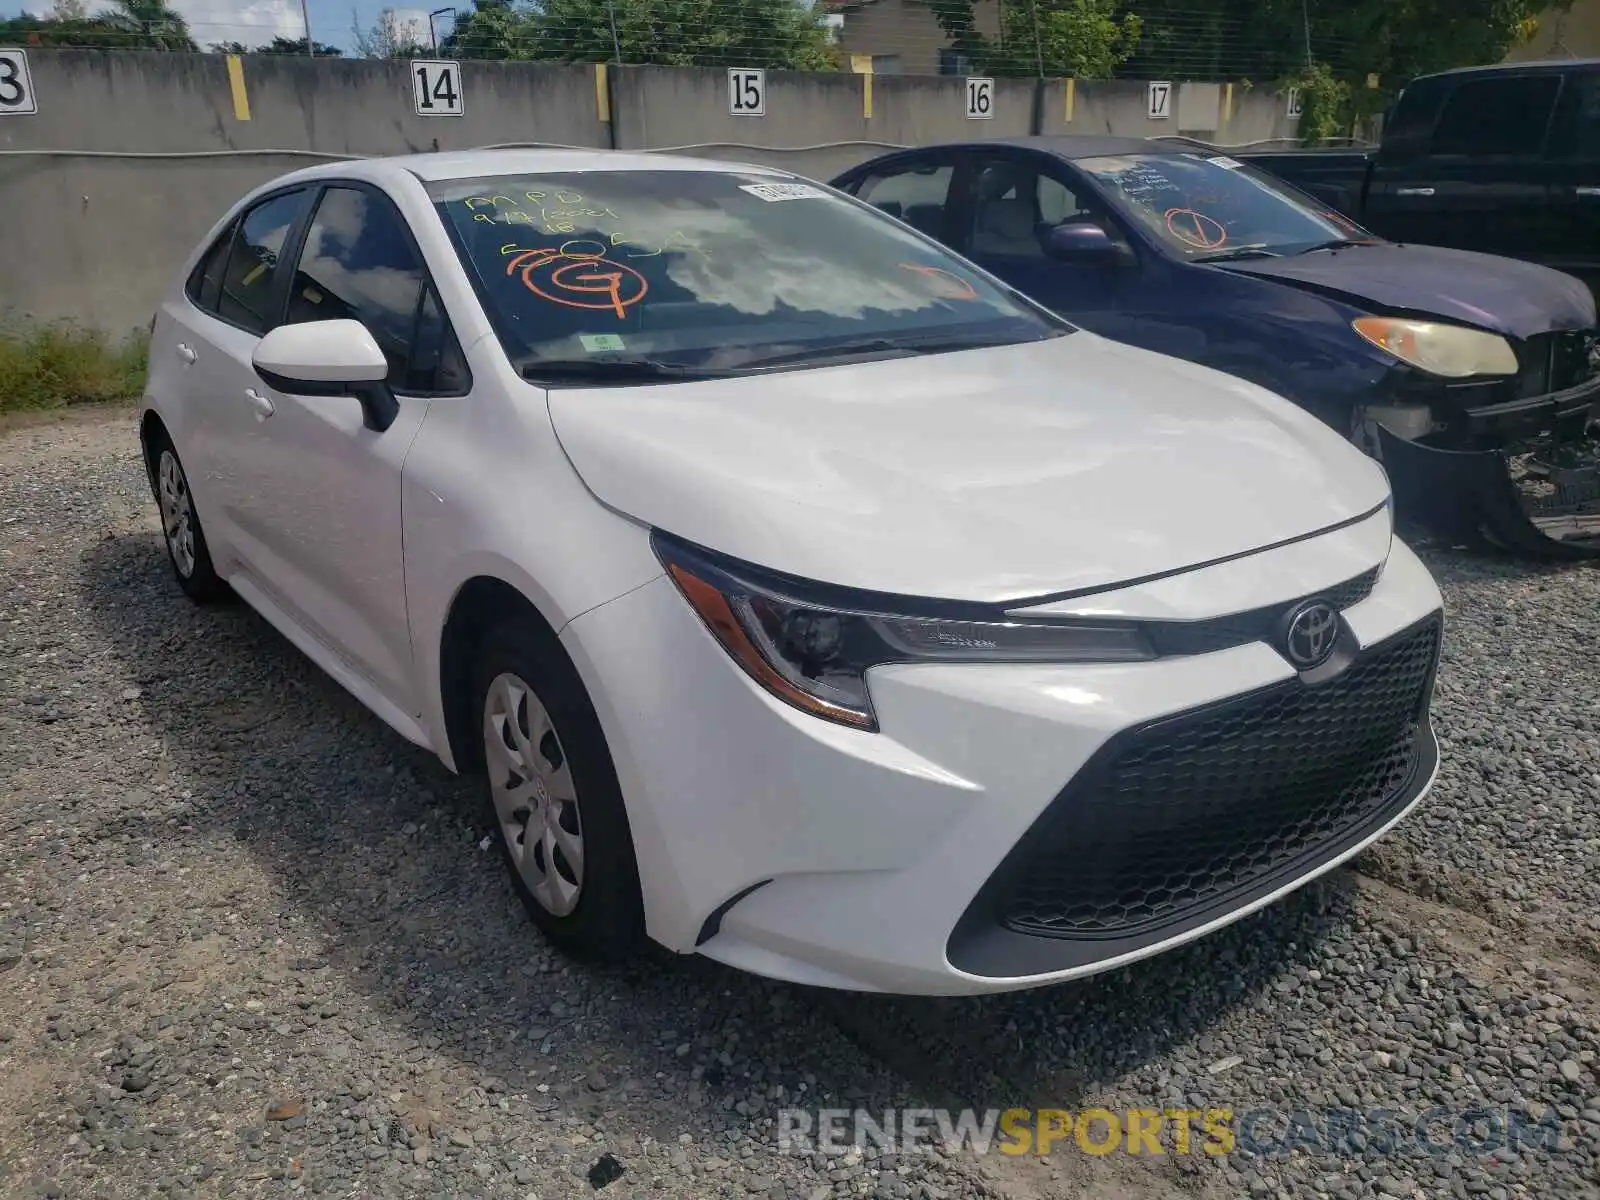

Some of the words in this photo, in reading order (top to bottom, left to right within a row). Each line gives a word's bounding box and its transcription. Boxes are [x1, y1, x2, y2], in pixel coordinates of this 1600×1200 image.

[416, 67, 457, 109] 14
[732, 74, 760, 110] 15
[969, 82, 990, 114] 16
[1151, 87, 1168, 113] 17
